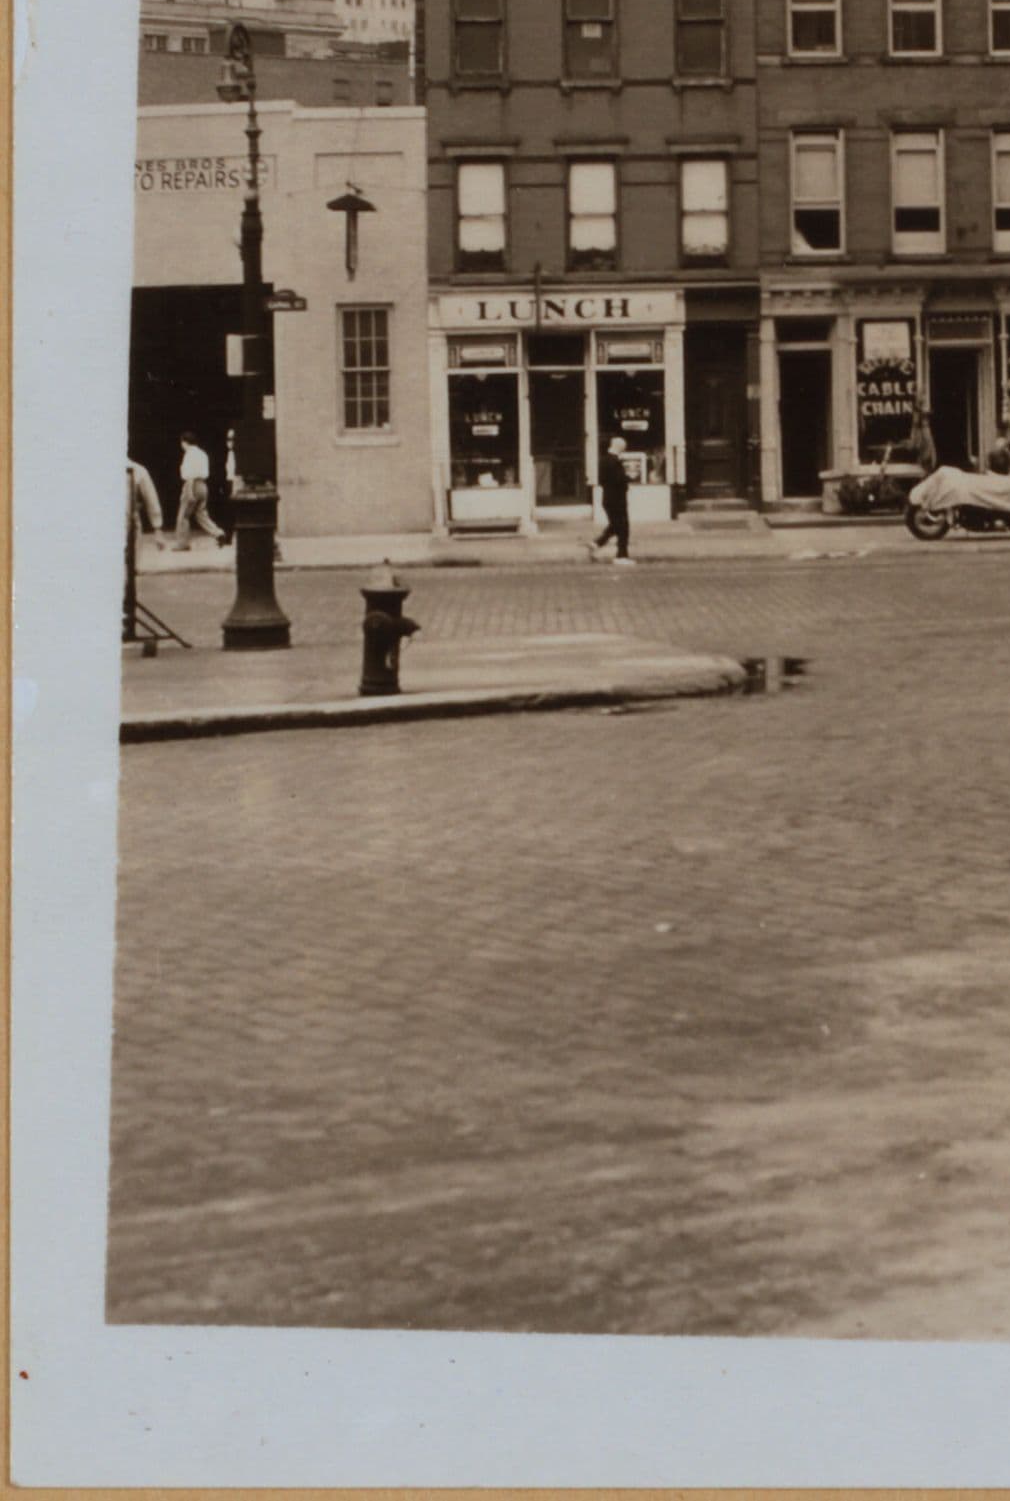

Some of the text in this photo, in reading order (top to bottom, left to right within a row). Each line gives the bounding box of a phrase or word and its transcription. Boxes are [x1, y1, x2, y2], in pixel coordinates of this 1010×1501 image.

[175, 157, 226, 171] BROS
[161, 170, 240, 190] REPAIRS
[477, 297, 631, 320] LUNCH
[858, 381, 916, 396] CABLE
[613, 408, 651, 419] LUNCH
[861, 400, 913, 416] CHAIN
[464, 412, 503, 423] LUNCH
